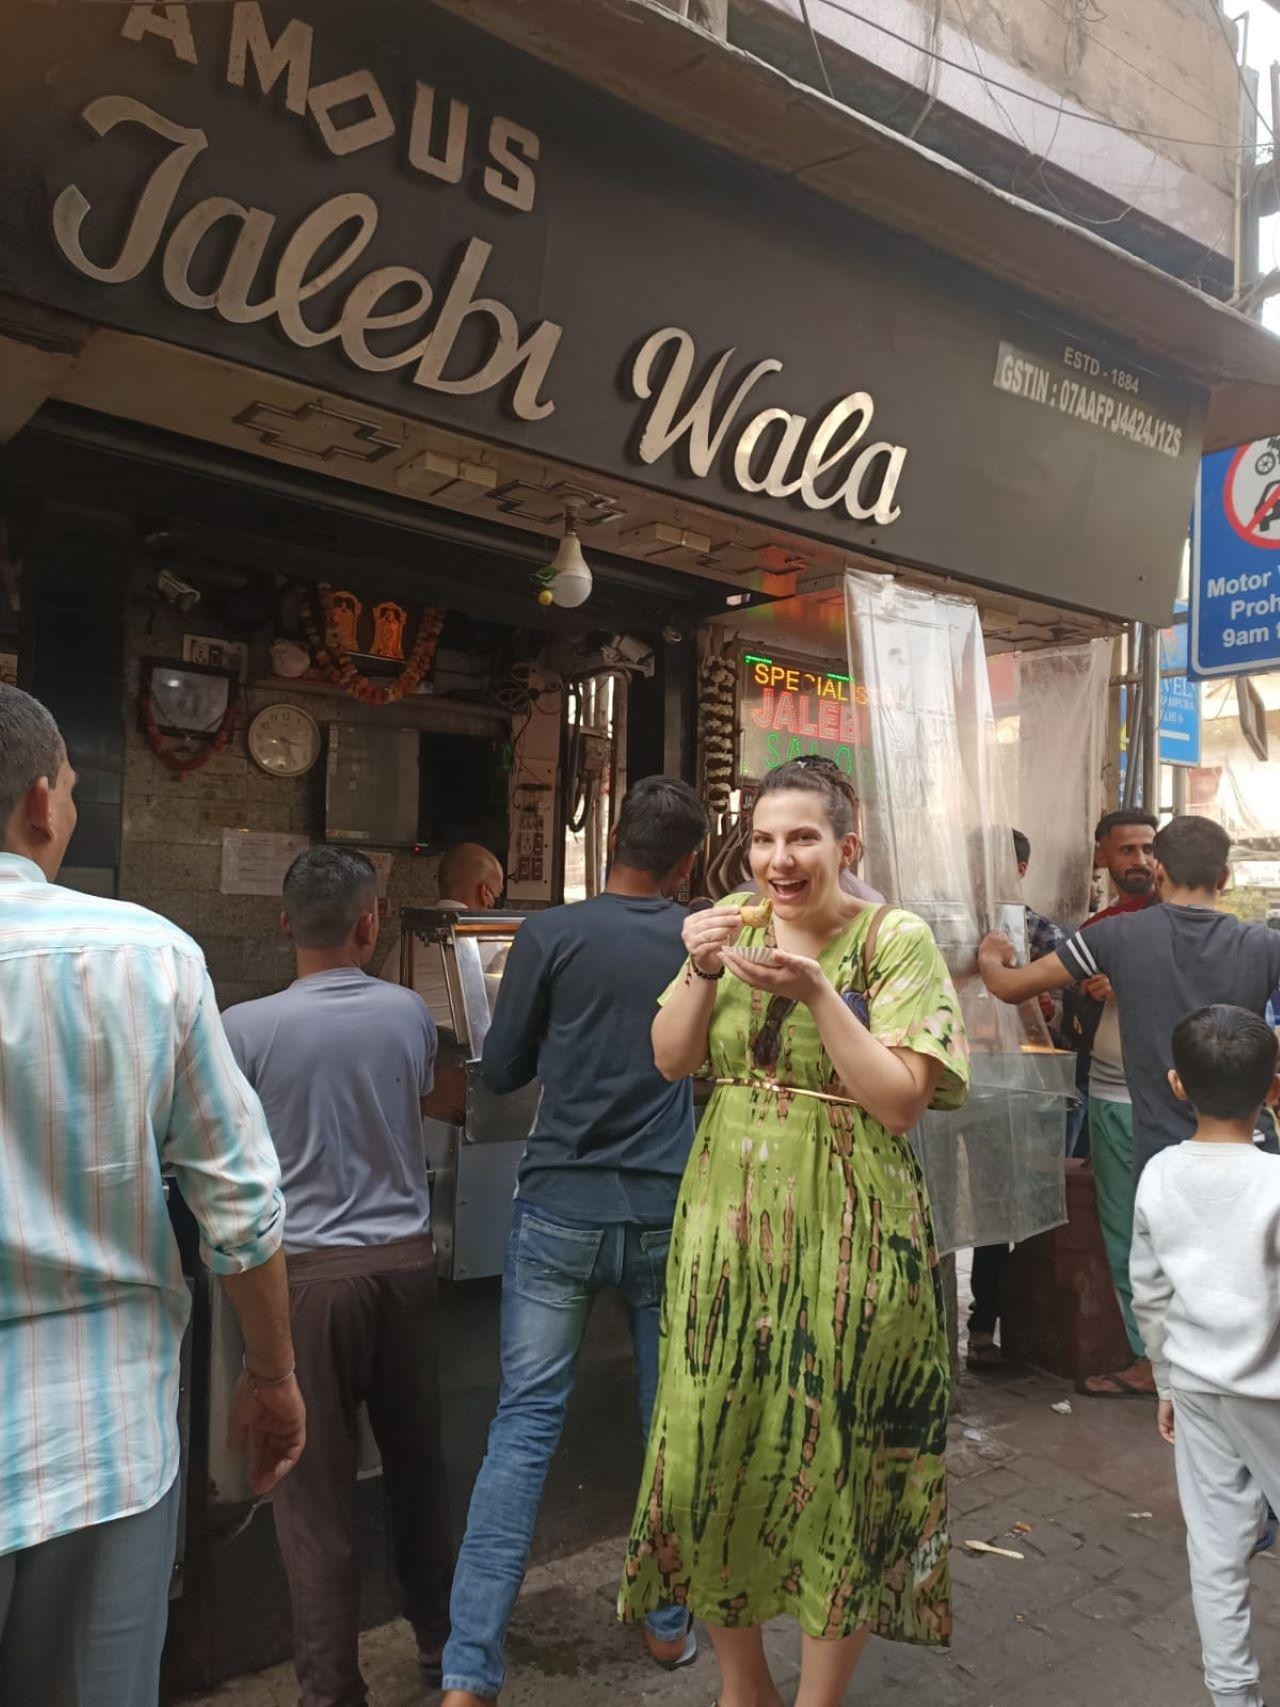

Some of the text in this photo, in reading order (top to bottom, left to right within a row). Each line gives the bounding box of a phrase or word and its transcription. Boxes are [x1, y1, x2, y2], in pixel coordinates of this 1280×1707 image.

[53, 95, 907, 526] Jalebi Wala
[1001, 355, 1050, 403] GSTIN
[1064, 347, 1100, 376] ESTD
[1111, 369, 1140, 393] 1884
[1207, 571, 1272, 598] Motor
[1223, 627, 1269, 648] 9am
